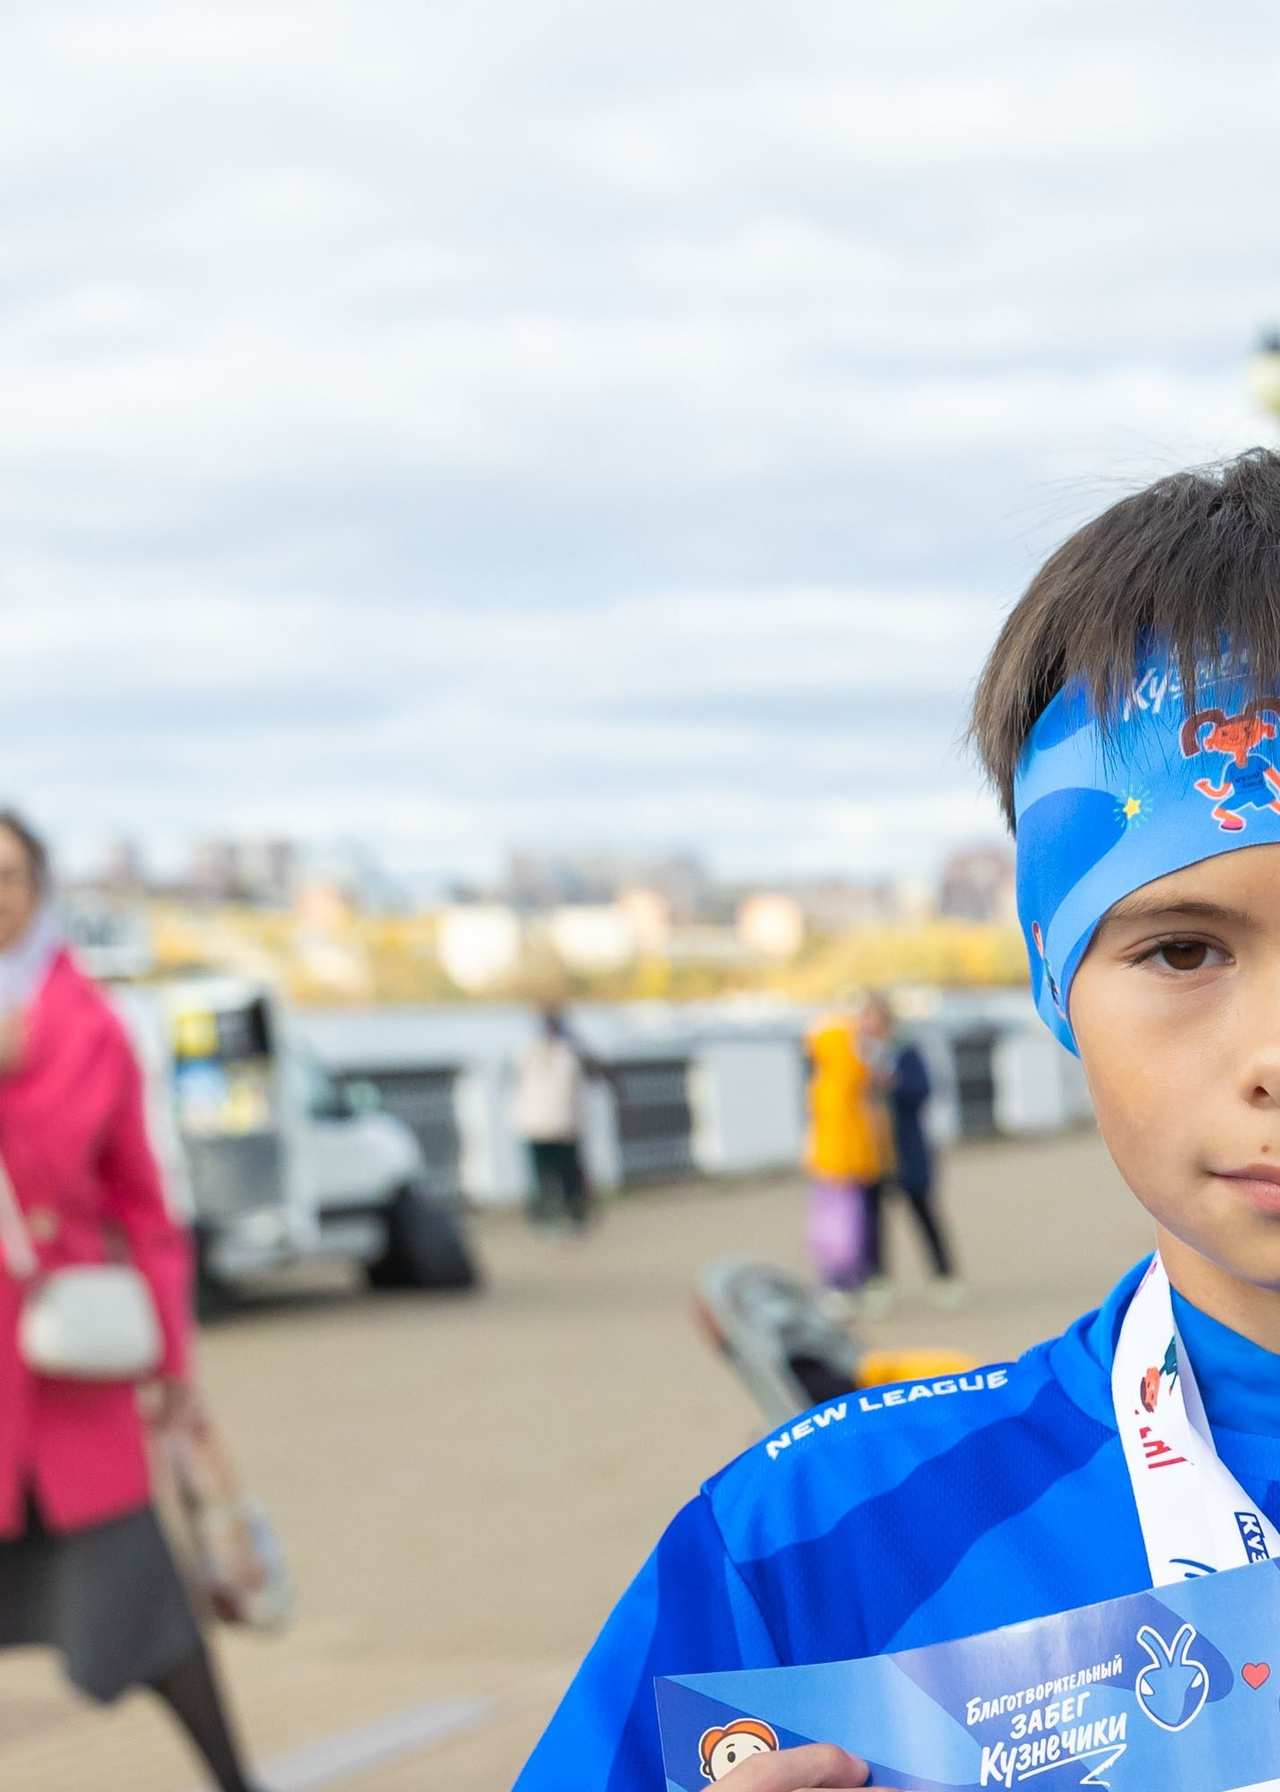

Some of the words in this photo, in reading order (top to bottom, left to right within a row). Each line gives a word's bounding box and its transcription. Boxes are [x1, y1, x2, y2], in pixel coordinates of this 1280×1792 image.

[765, 1402, 847, 1460] NEW
[858, 1369, 1008, 1413] LEAGUE
[980, 1712, 1127, 1788] Кузнечики
[1010, 1691, 1091, 1740] ЗАБЕГ
